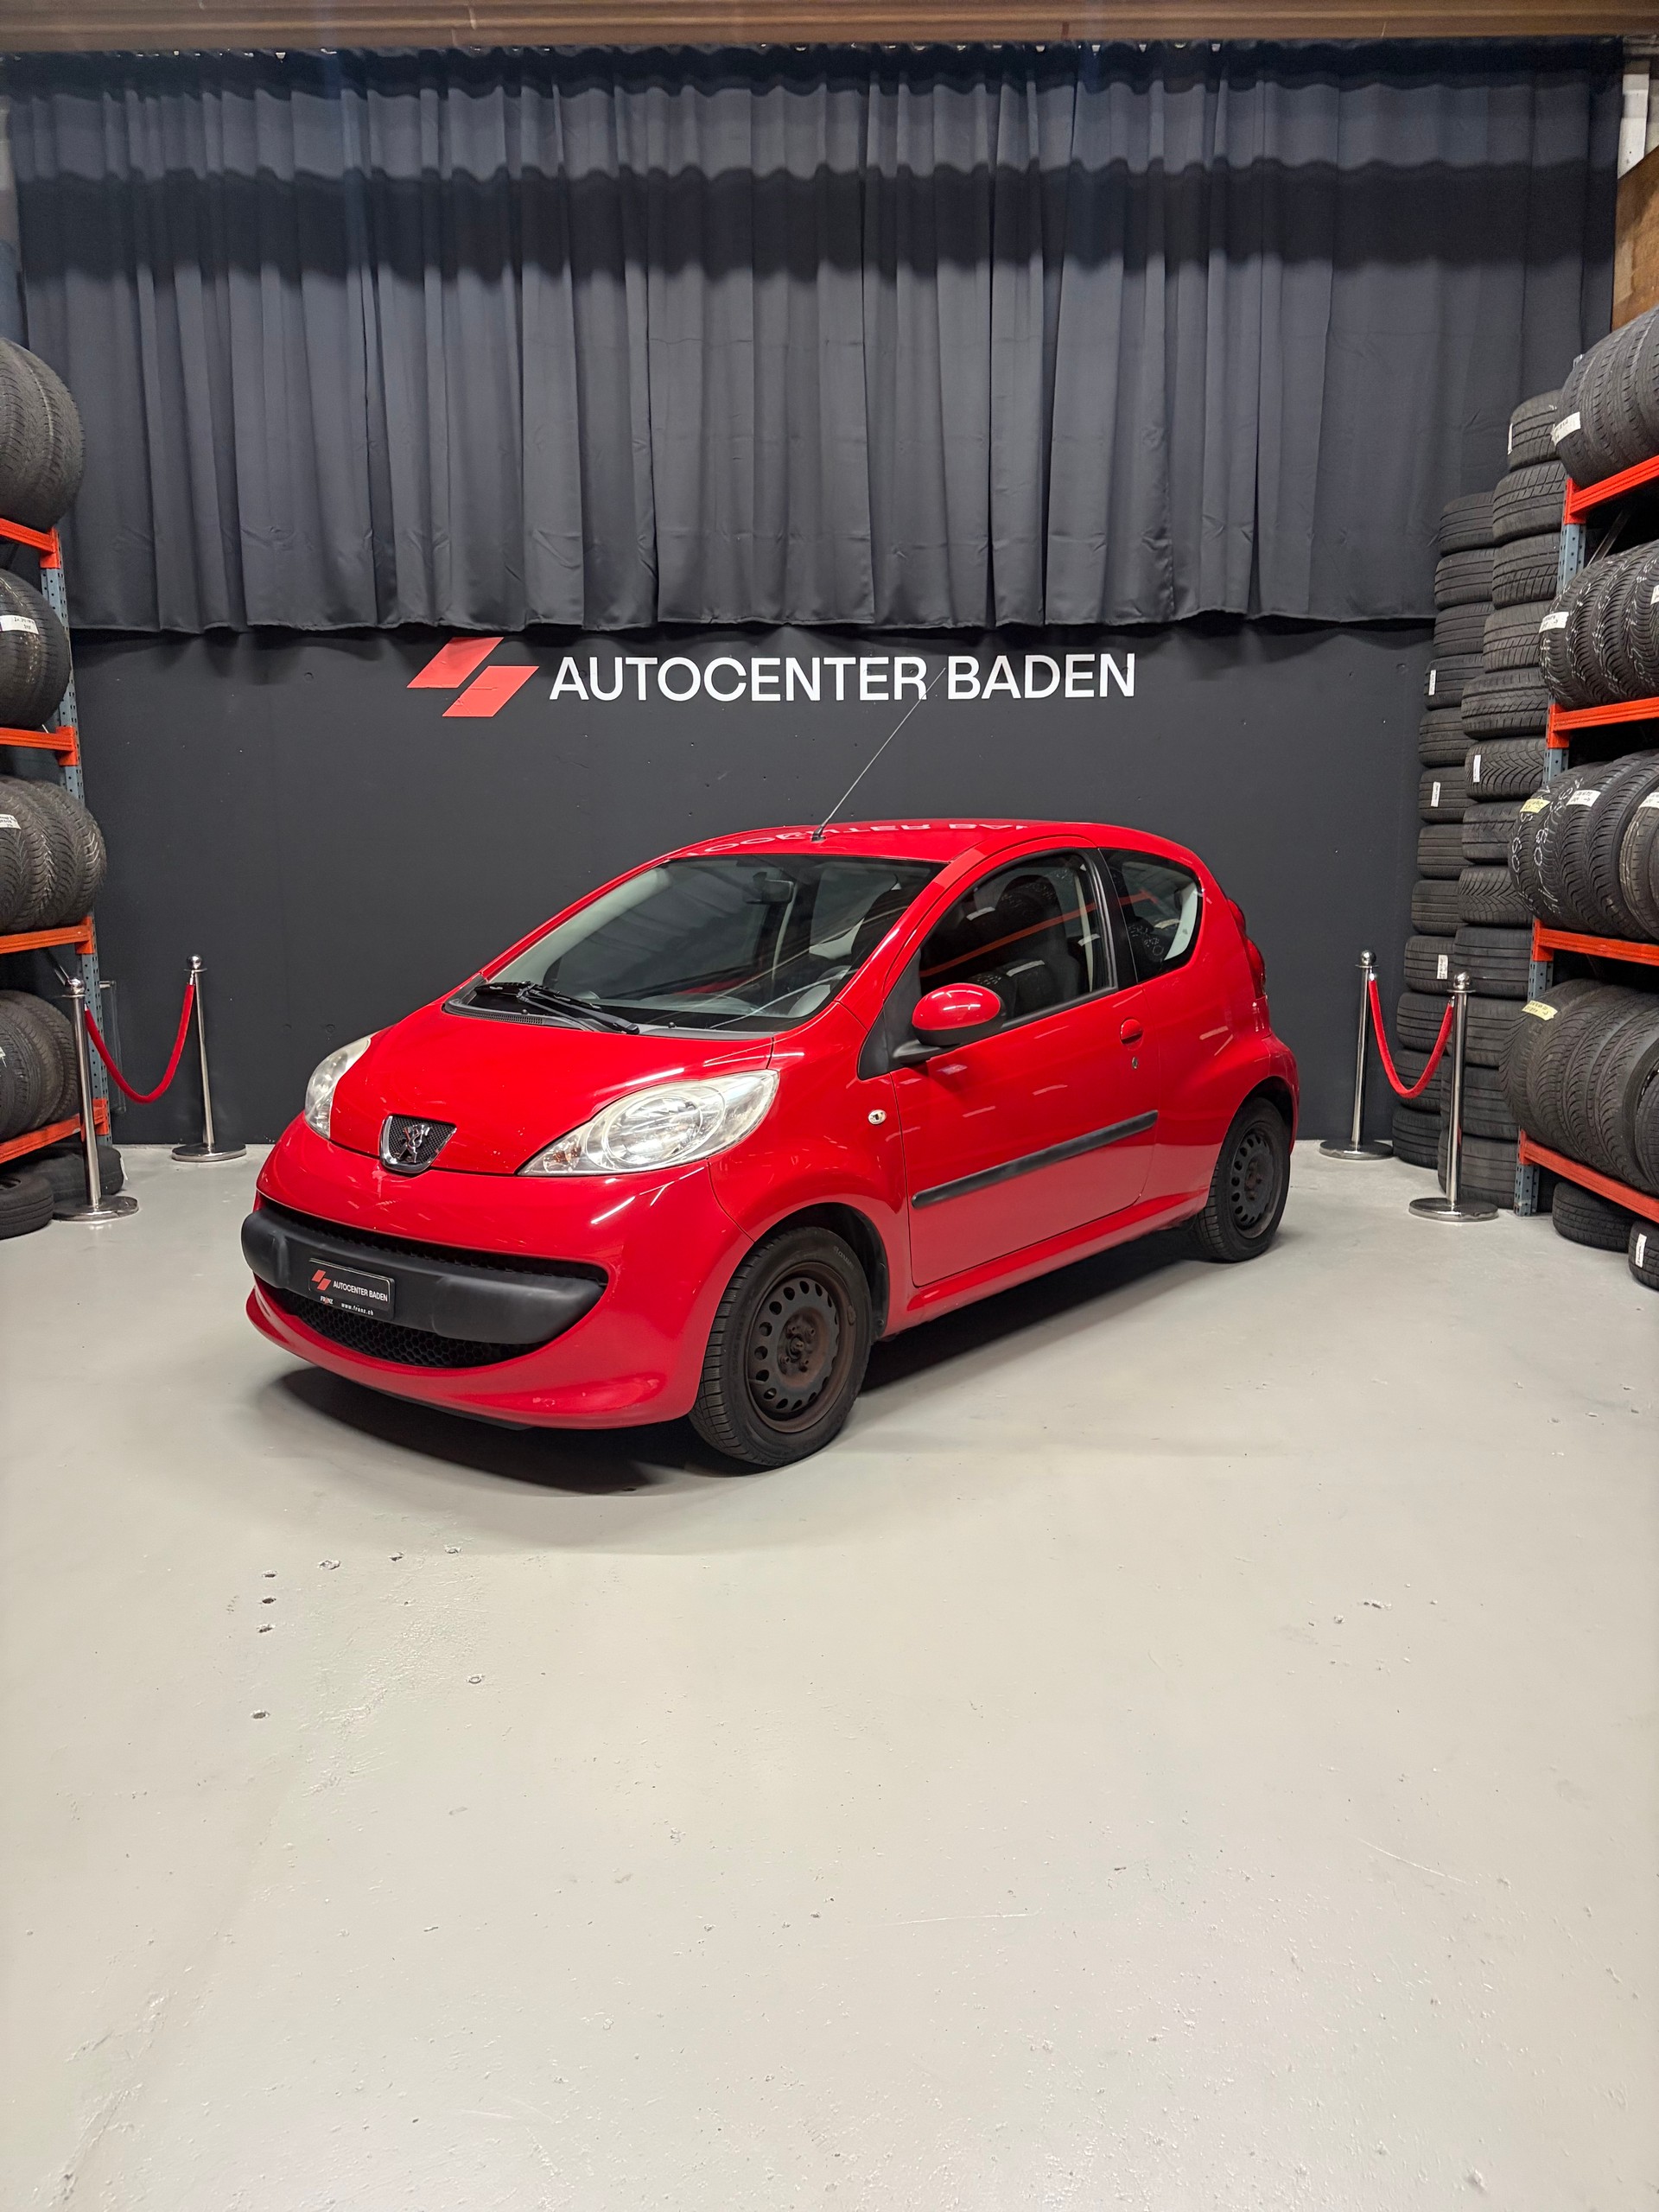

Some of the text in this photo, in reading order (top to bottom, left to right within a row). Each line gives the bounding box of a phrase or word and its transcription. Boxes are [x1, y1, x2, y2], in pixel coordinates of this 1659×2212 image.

[549, 652, 1135, 702] AUTOCENTER BADEN
[333, 1281, 388, 1302] AUTOCENTER BADEN
